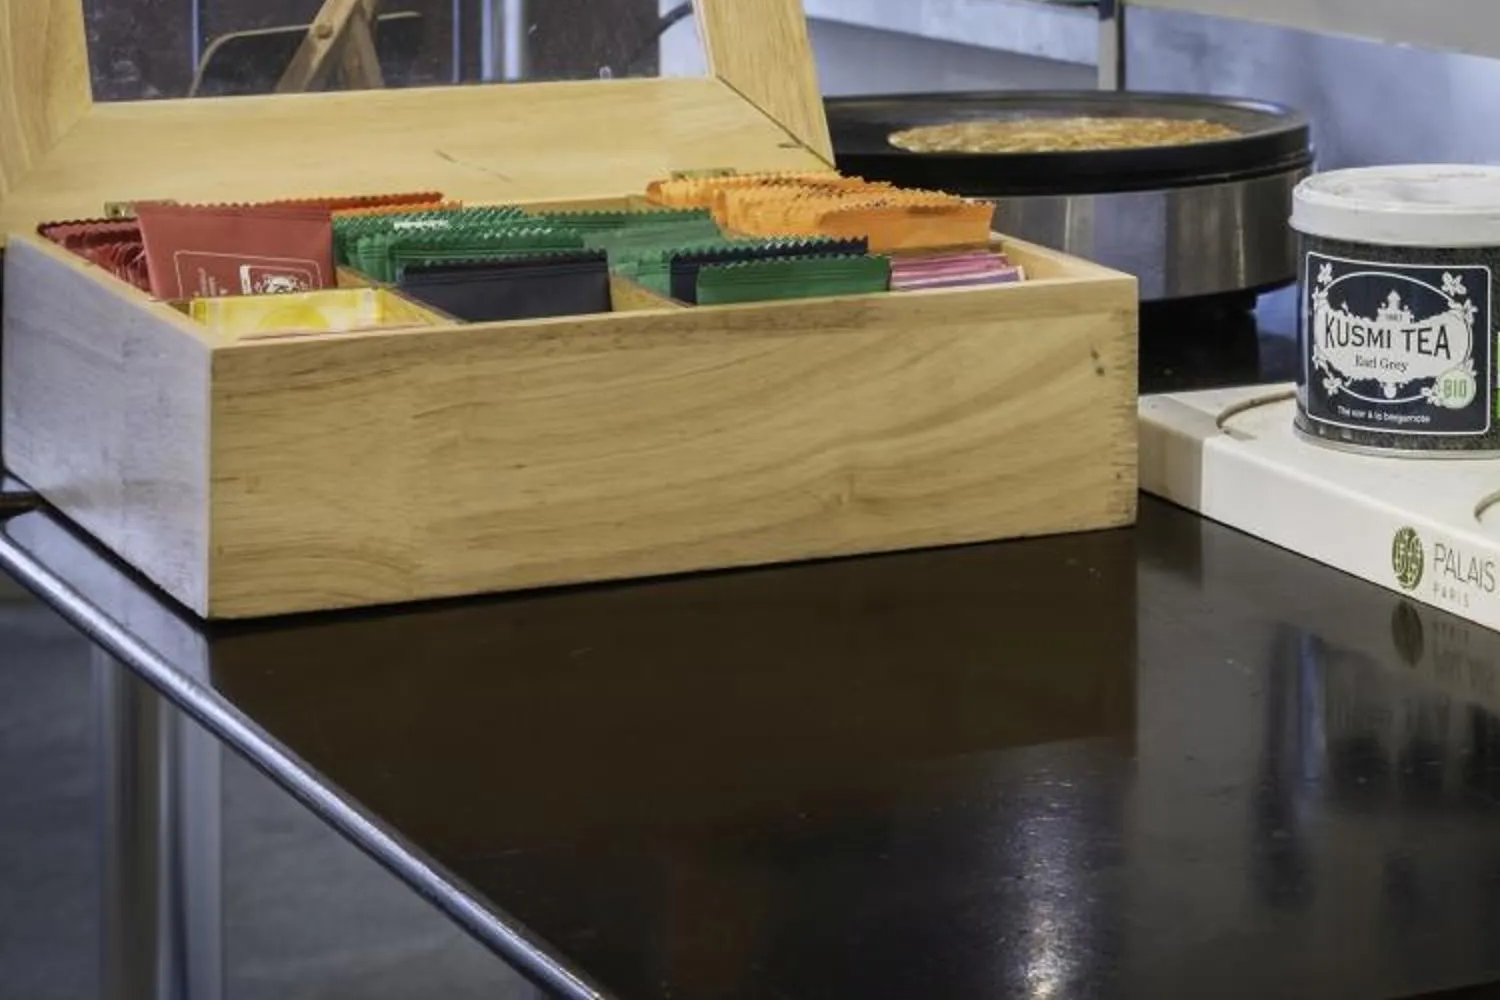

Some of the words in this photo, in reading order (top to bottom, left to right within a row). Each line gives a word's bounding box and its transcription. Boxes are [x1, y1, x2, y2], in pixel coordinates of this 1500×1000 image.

[1325, 311, 1391, 349] KUSMI
[1401, 325, 1451, 360] TEA
[1355, 355, 1377, 369] Earl
[1380, 358, 1409, 372] Grey
[1443, 378, 1468, 398] BIO
[1433, 543, 1495, 592] PALAIS
